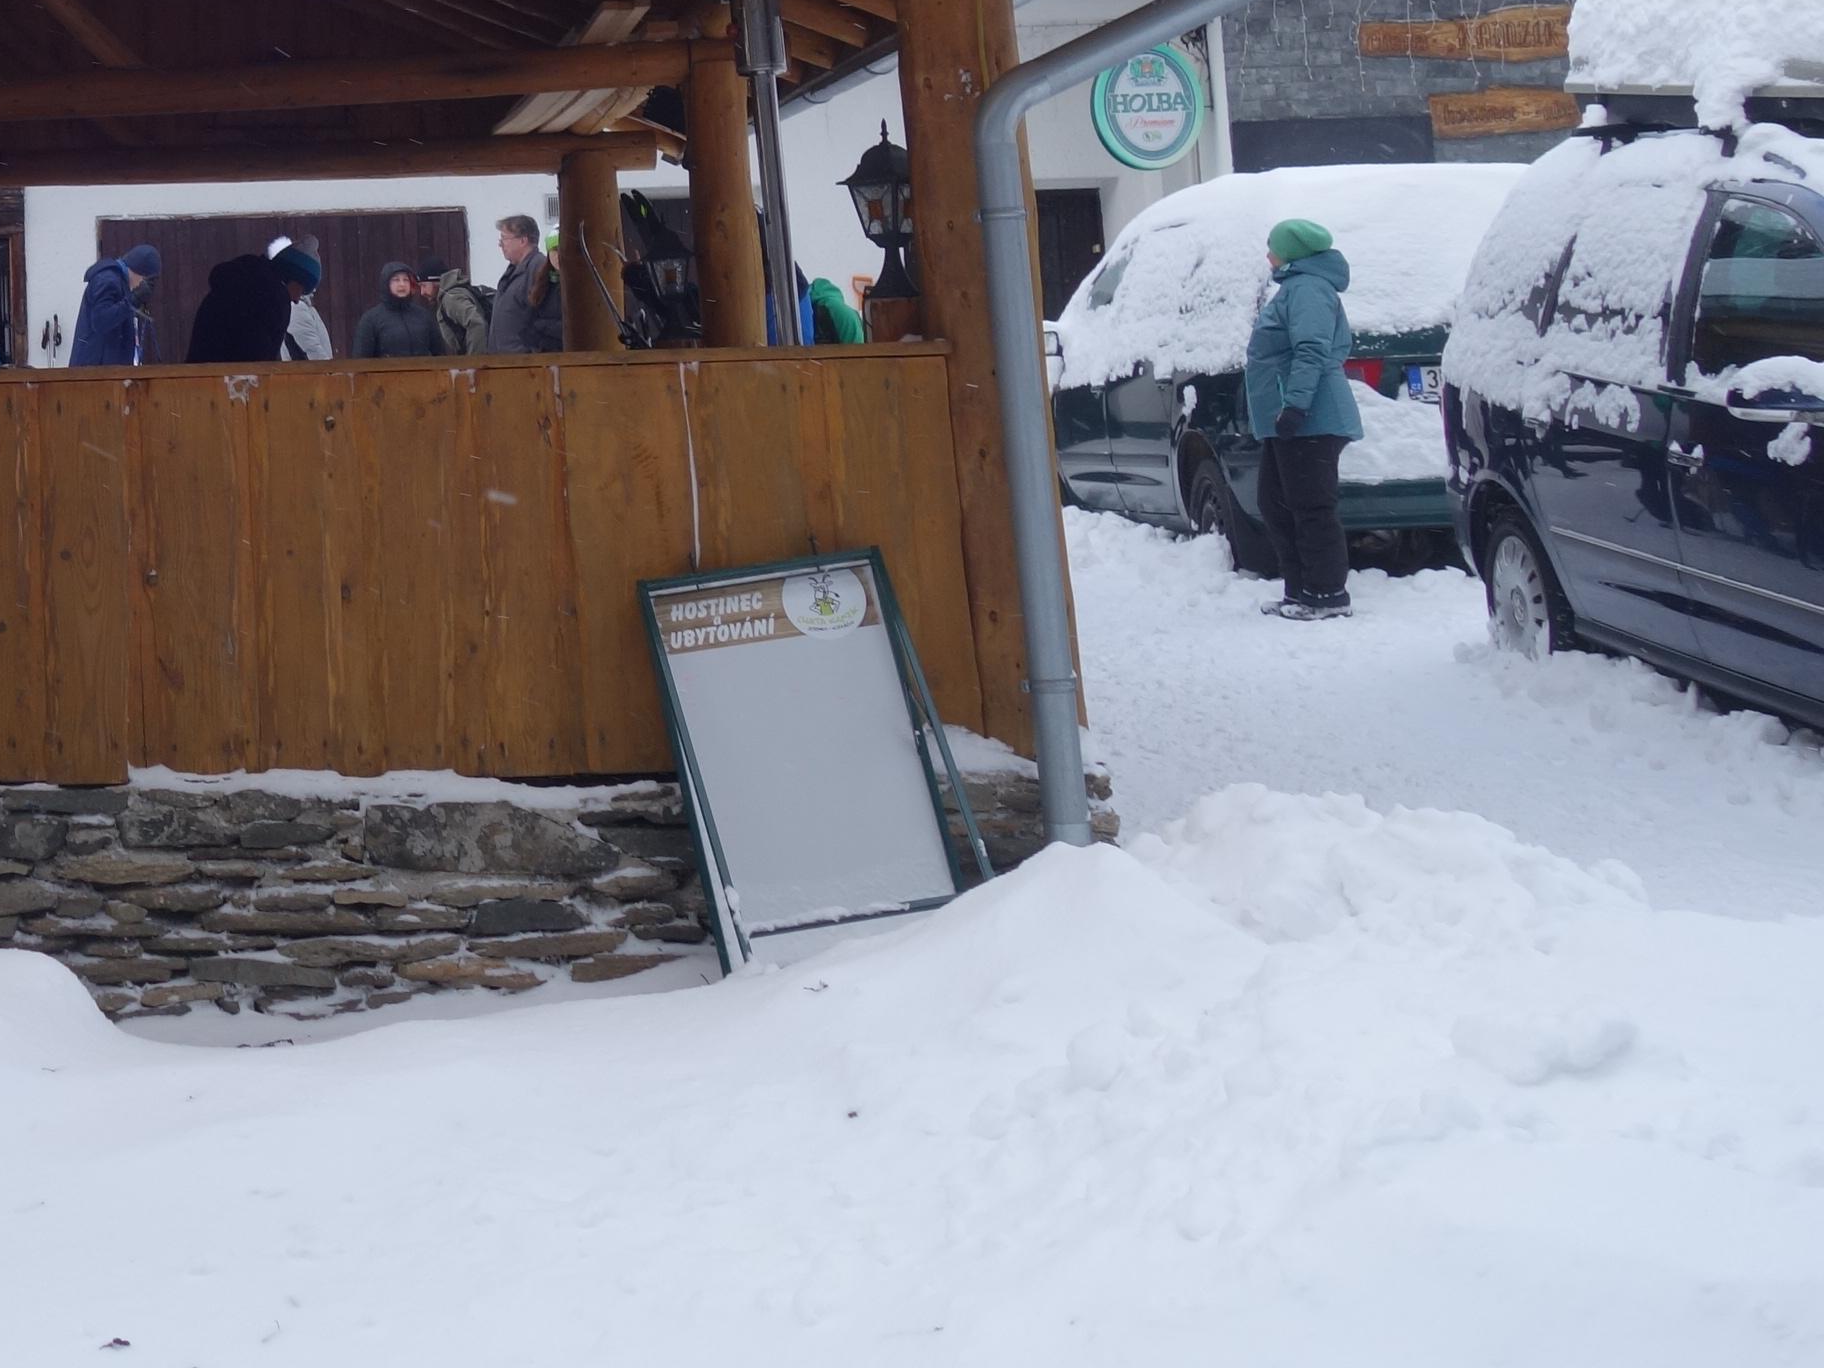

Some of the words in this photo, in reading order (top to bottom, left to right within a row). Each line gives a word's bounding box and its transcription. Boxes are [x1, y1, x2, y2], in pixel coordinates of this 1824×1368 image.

[1109, 92, 1192, 113] HOLBA
[671, 592, 763, 622] HOSTINEC
[671, 613, 775, 649] UBYTOVÁNÍ
